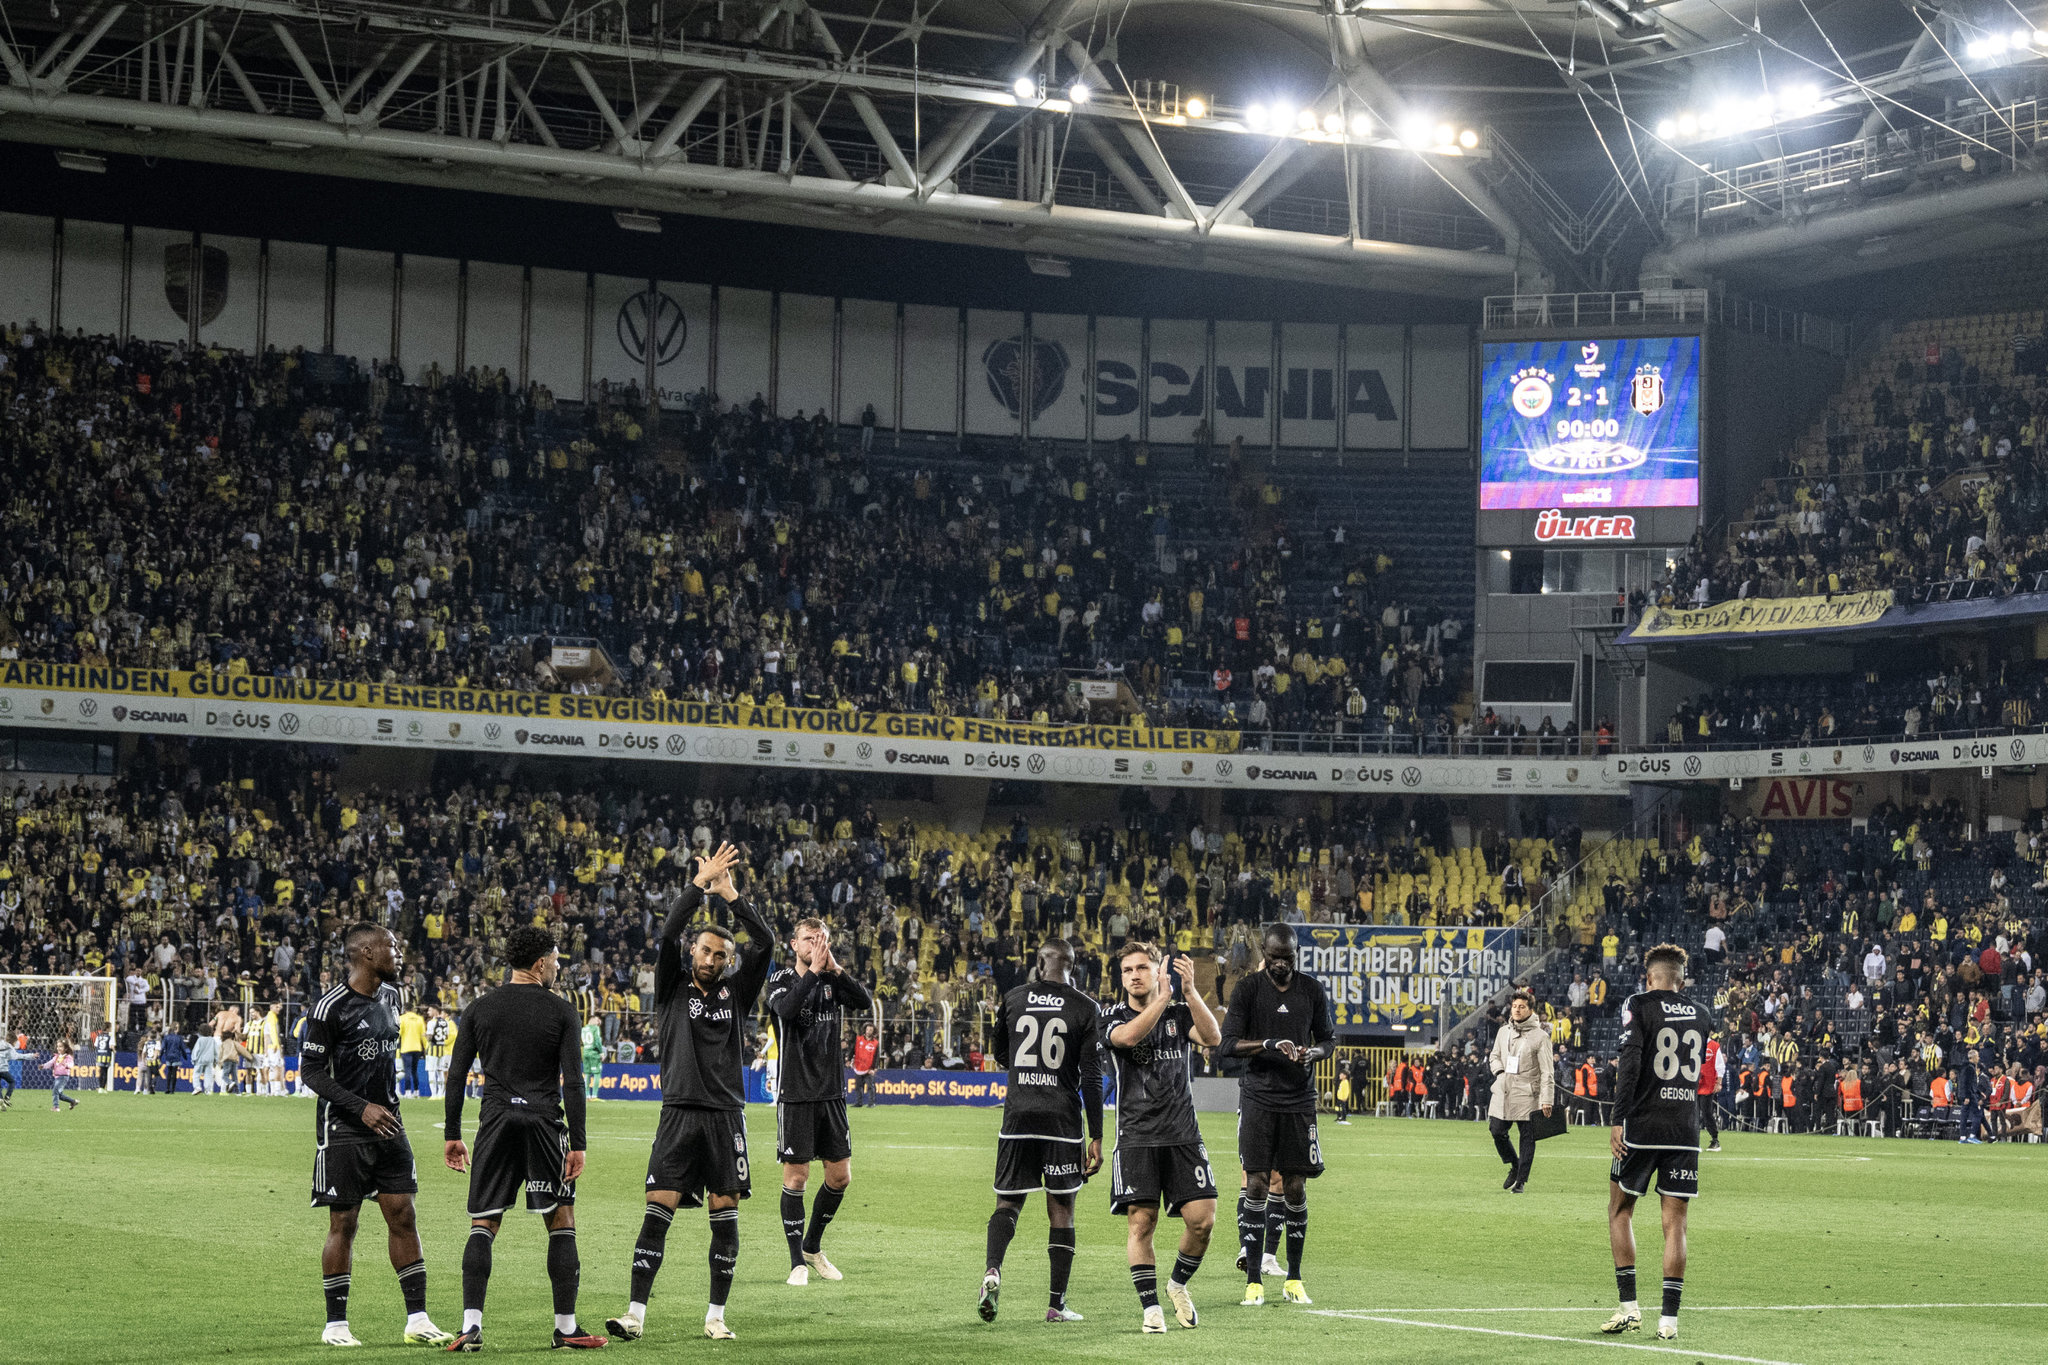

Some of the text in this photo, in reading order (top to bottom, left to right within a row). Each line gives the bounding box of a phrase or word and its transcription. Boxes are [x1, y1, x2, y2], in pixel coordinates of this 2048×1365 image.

[1080, 360, 1398, 421] SCANIA
[1557, 418, 1619, 440] 90:00
[1535, 509, 1635, 541] ÜLKER
[0, 662, 178, 697] ARIHINDEN,
[367, 684, 551, 718] FENERBAHÇE
[886, 716, 956, 741] GENÇ
[129, 710, 189, 723] SCANIA
[530, 733, 586, 746] SCANIA
[899, 753, 950, 766] SCANIA
[1901, 750, 1940, 764] SCANIA
[1262, 768, 1318, 781] SCANIA
[1760, 778, 1854, 818] AVIS
[1295, 945, 1414, 973] EMEMBER
[1419, 947, 1512, 976] HISTORY
[1027, 991, 1066, 1007] beko
[1317, 975, 1363, 1004] CUS
[1369, 976, 1401, 1004] ON
[1660, 1000, 1697, 1016] beko
[1014, 1014, 1069, 1070] 26
[1153, 1047, 1183, 1062] Rain
[1652, 1027, 1703, 1083] 83
[619, 1074, 649, 1093] App
[1018, 1072, 1058, 1088] MASUAKU
[927, 1081, 948, 1097] SK
[948, 1081, 983, 1101] Super
[1660, 1087, 1696, 1102] GEDSON
[736, 1157, 748, 1182] 9
[1048, 1162, 1080, 1177] PASHA
[1194, 1164, 1215, 1189] 90
[525, 1180, 553, 1193] ASHA
